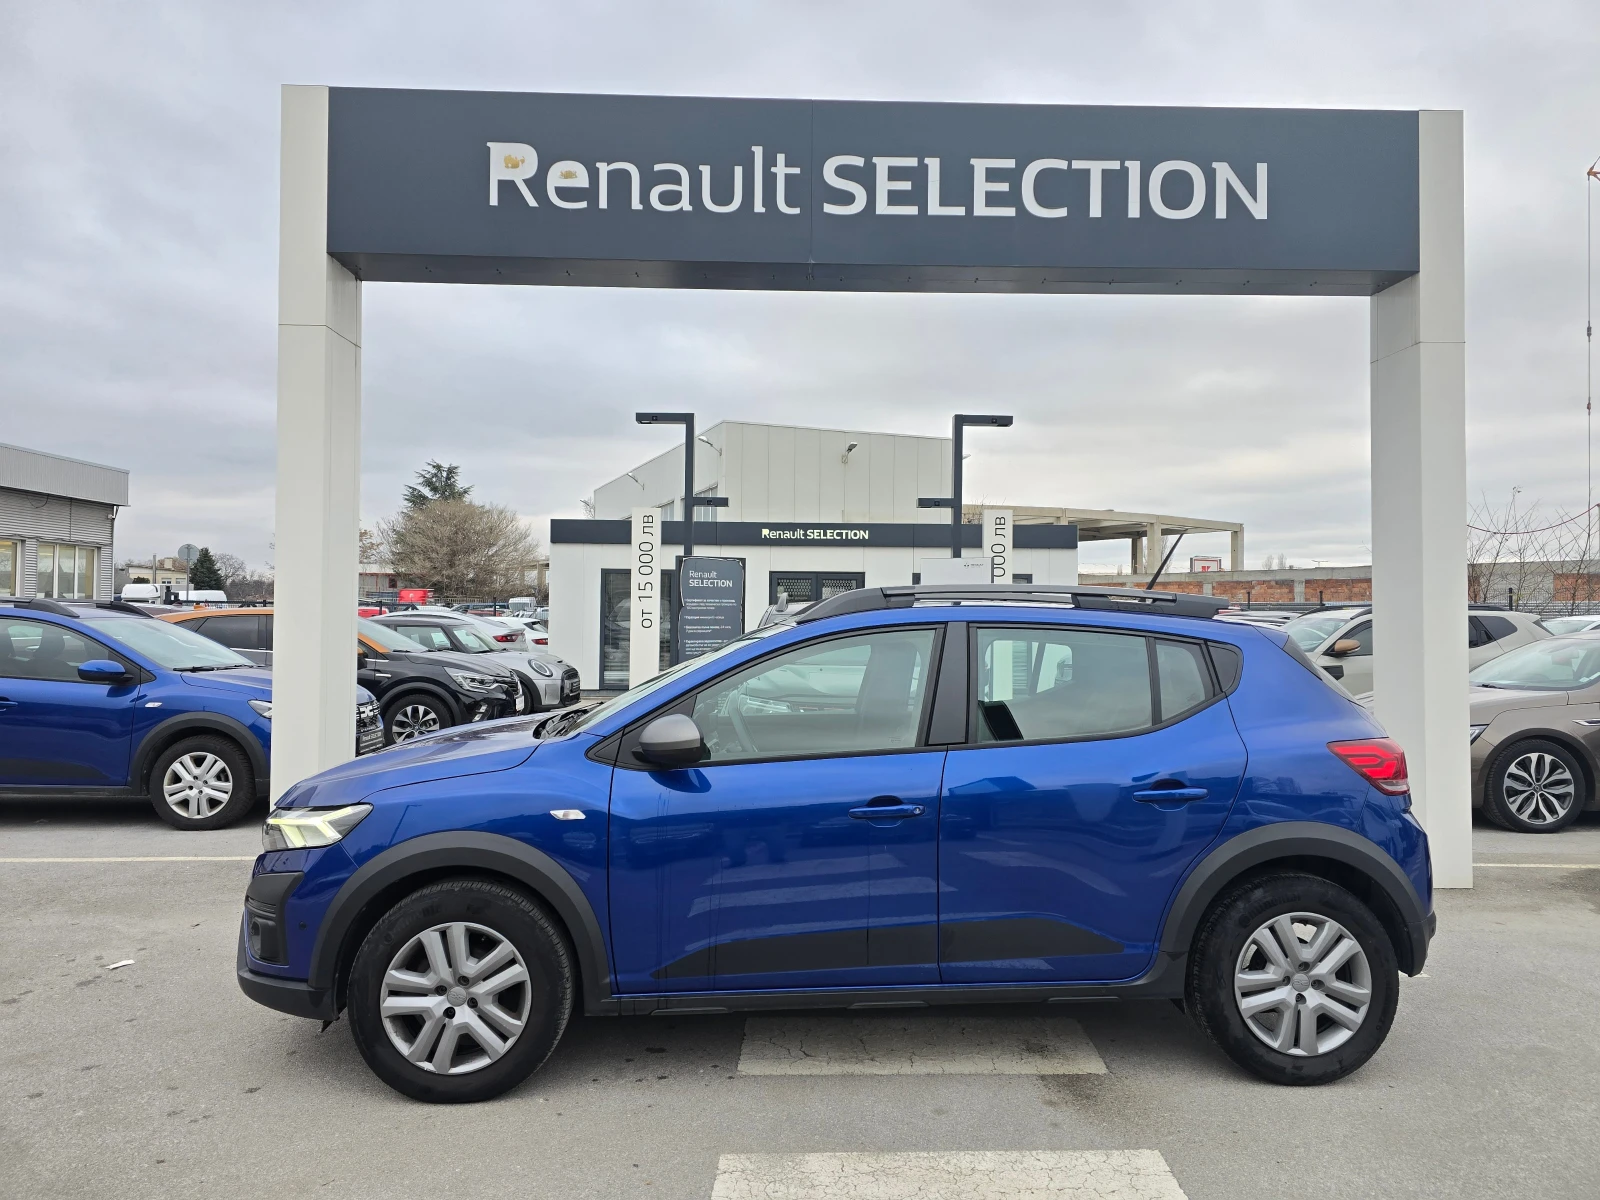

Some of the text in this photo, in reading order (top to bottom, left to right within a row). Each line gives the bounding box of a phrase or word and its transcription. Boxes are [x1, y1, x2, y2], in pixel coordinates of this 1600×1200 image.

[486, 141, 1268, 220] Renault SELECTION
[761, 528, 869, 540] Renault SELECTION
[638, 541, 654, 576] 000
[689, 570, 718, 579] Renault
[638, 581, 653, 602] 15
[688, 579, 733, 588] SELECTION
